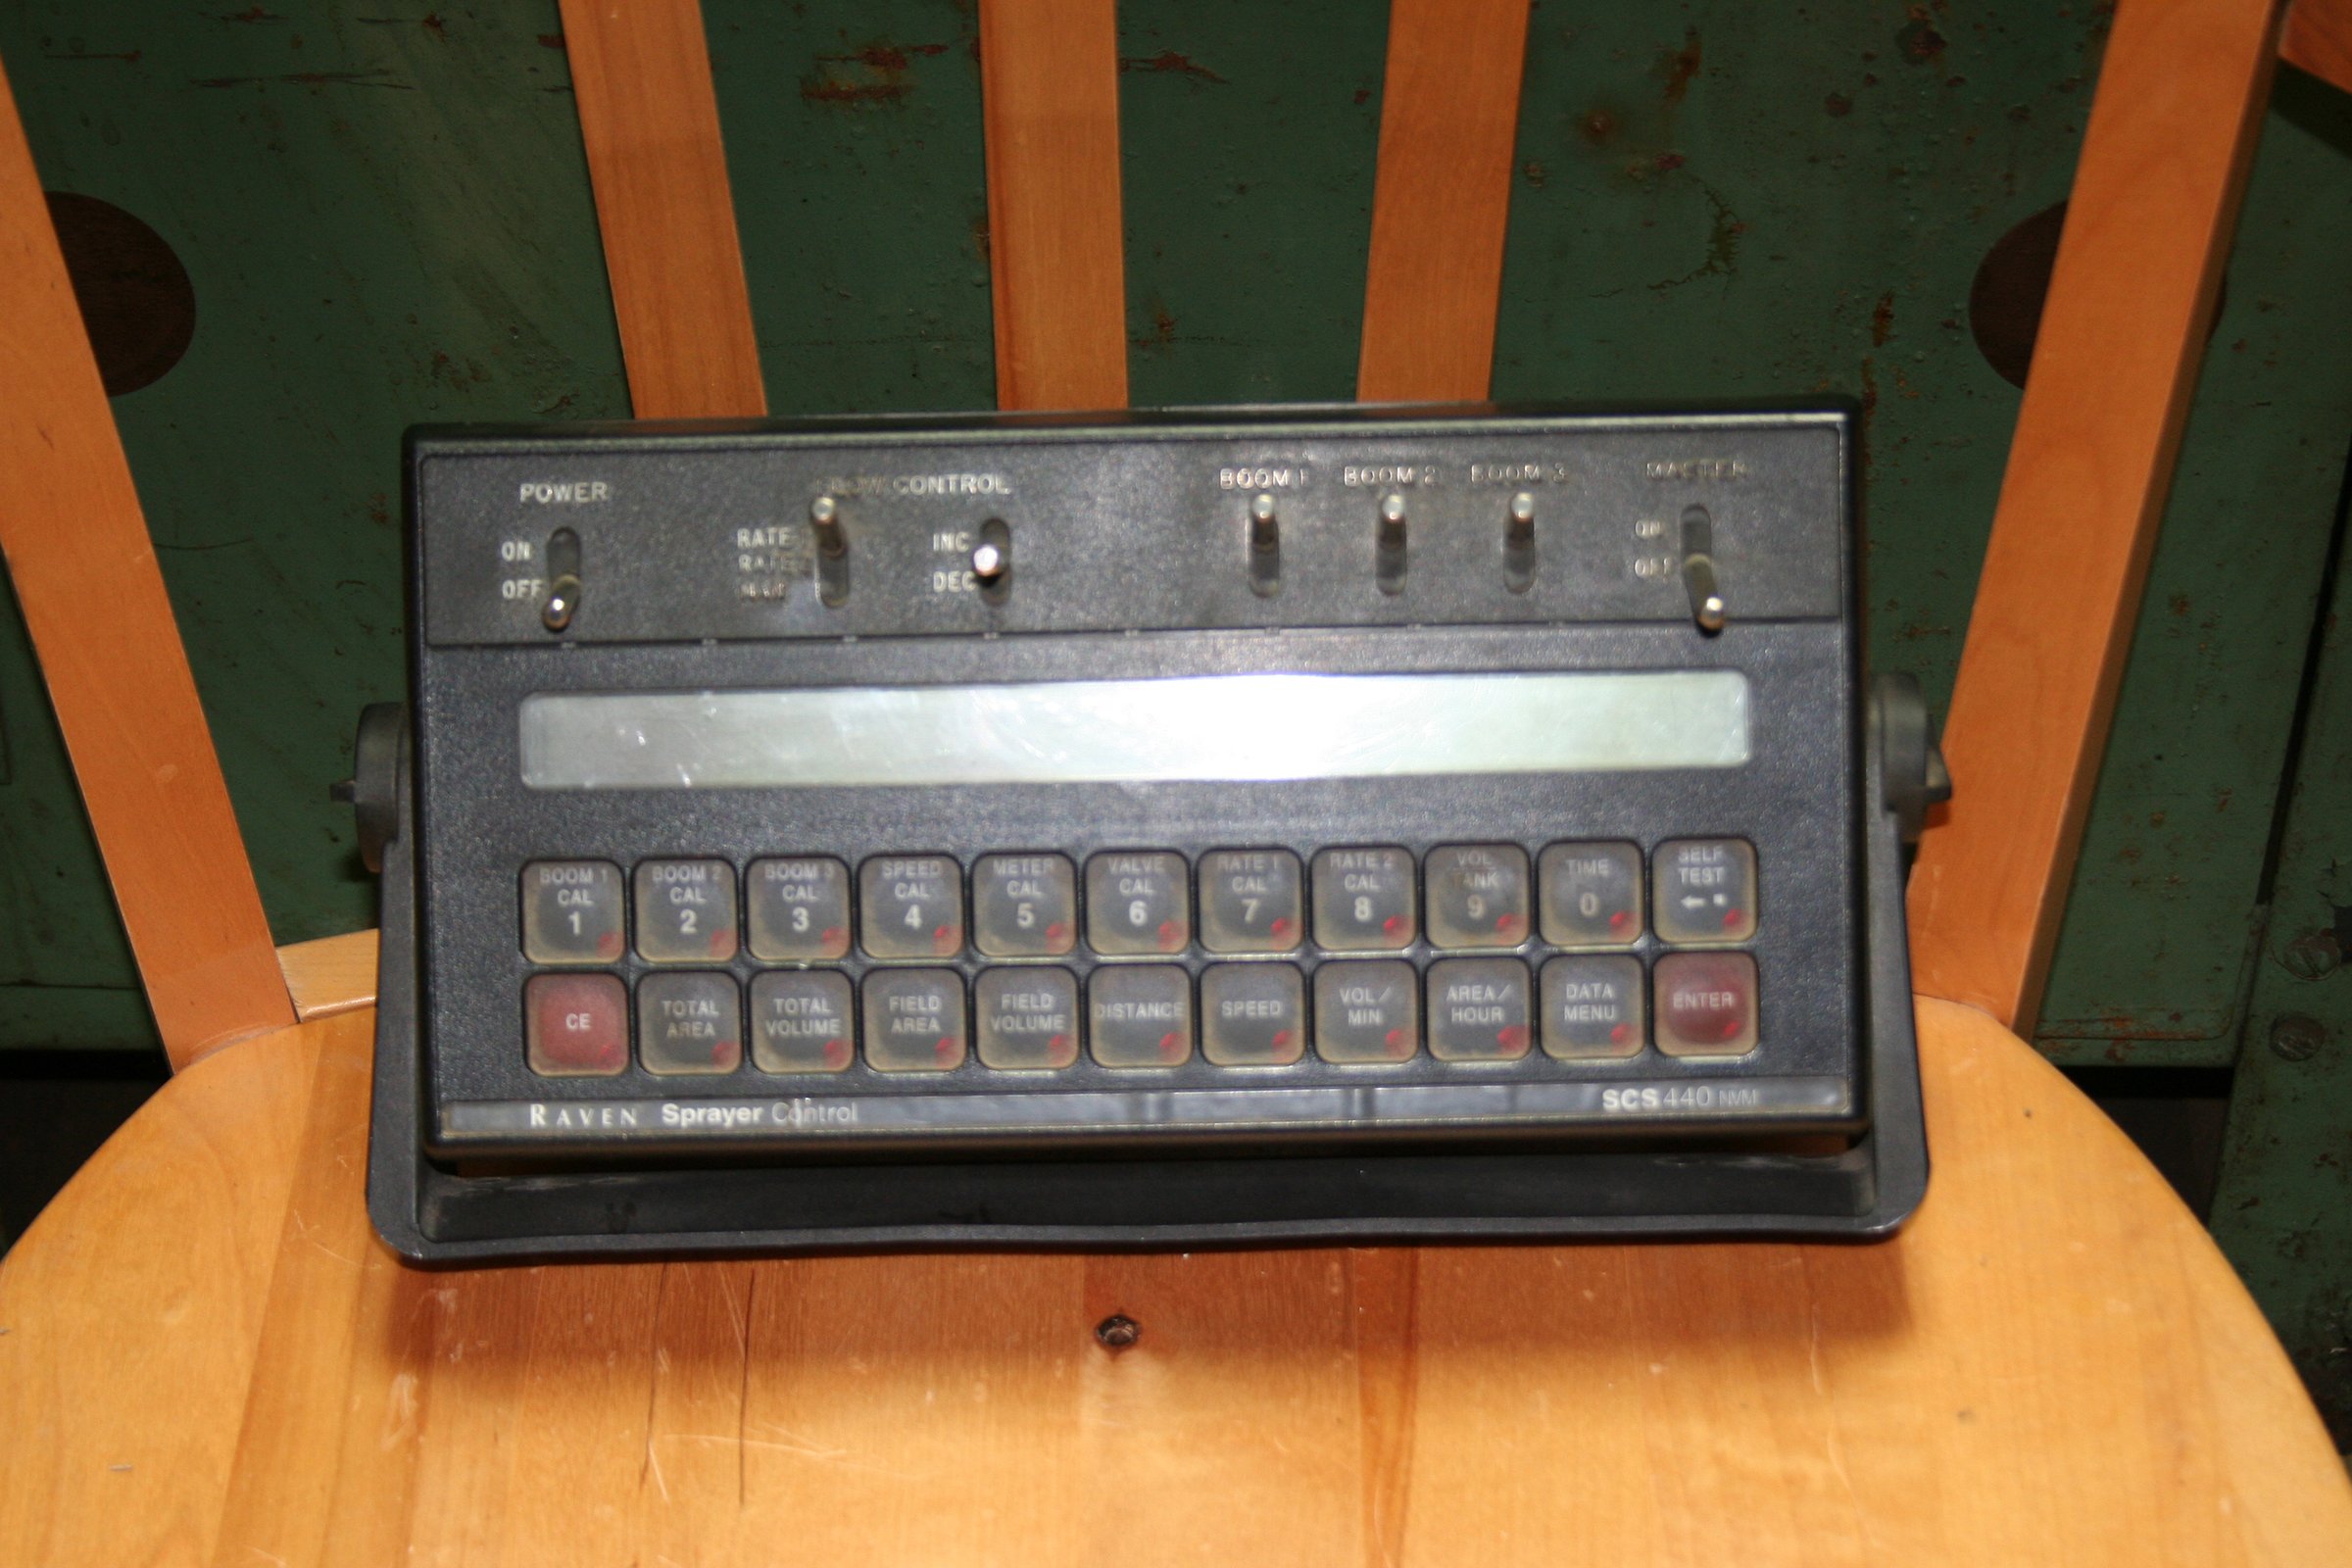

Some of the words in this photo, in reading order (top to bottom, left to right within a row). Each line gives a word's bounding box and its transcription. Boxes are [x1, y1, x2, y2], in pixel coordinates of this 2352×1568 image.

[1219, 468, 1288, 489] BOOM
[1344, 466, 1413, 485] BOOM
[1424, 466, 1438, 485] 2
[1471, 465, 1541, 482] BOOM
[519, 481, 610, 504] POWER
[893, 473, 1010, 496] CONTROL
[737, 527, 792, 549] RATE
[1635, 520, 1663, 539] ON
[933, 532, 969, 553] INC
[501, 541, 531, 562] ON
[502, 579, 543, 601] OFF
[933, 570, 977, 593] DEC
[1217, 856, 1266, 871] RATE
[1271, 855, 1279, 869] 1
[1330, 854, 1380, 869] RATE
[1384, 854, 1394, 868] 2
[1456, 851, 1492, 866] VOL
[1678, 847, 1725, 863] SELF
[652, 866, 707, 882] BOOM
[712, 865, 722, 881] 2
[764, 864, 819, 880] BOOM
[823, 863, 835, 879] 3
[882, 860, 943, 878] SPEED
[993, 858, 1054, 875] METER
[1107, 857, 1166, 873] VALVE
[1565, 859, 1610, 876] TIME
[539, 867, 594, 884] BOOM
[600, 867, 609, 882] 1
[1344, 873, 1382, 890] CAL
[1678, 866, 1725, 884] TEST
[894, 883, 931, 900] CAL
[1006, 881, 1045, 898] CAL
[1118, 878, 1156, 895] CAL
[1231, 876, 1267, 893] CAL
[558, 889, 593, 906] CAL
[669, 887, 706, 904] CAL
[782, 884, 818, 903] CAL
[1128, 900, 1148, 926] 6
[1241, 898, 1260, 923] 7
[1353, 896, 1373, 922] 8
[1466, 894, 1485, 919] 9
[1579, 893, 1598, 917] 0
[567, 910, 581, 934] 1
[679, 909, 698, 934] 2
[792, 906, 810, 931] 3
[904, 905, 923, 929] 4
[1016, 903, 1034, 928] 5
[1339, 987, 1392, 1004] VOL/
[1446, 984, 1511, 1002] AREA/
[1565, 984, 1614, 1000] DATA
[1673, 992, 1734, 1009] ENTER
[662, 1000, 720, 1017] TOTAL
[773, 998, 831, 1013] TOTAL
[889, 996, 942, 1012] FIELD
[1001, 994, 1055, 1010] FIELD
[1094, 1002, 1186, 1019] DISTANCE
[1221, 1000, 1283, 1017] SPEED
[1348, 1009, 1383, 1026] MIN
[1451, 1006, 1504, 1022] HOUR
[1564, 1004, 1615, 1021] MENU
[564, 1013, 591, 1031] CE
[665, 1021, 716, 1038] AREA
[765, 1019, 841, 1036] VOLUME
[891, 1017, 942, 1034] AREA
[990, 1015, 1066, 1031] VOLUME
[1601, 1087, 1658, 1111] SCS
[1662, 1085, 1711, 1107] 440
[1719, 1088, 1757, 1107] NVM
[529, 1103, 637, 1127] RAVEN
[662, 1102, 763, 1129] Sprayer
[771, 1102, 858, 1126] Control
